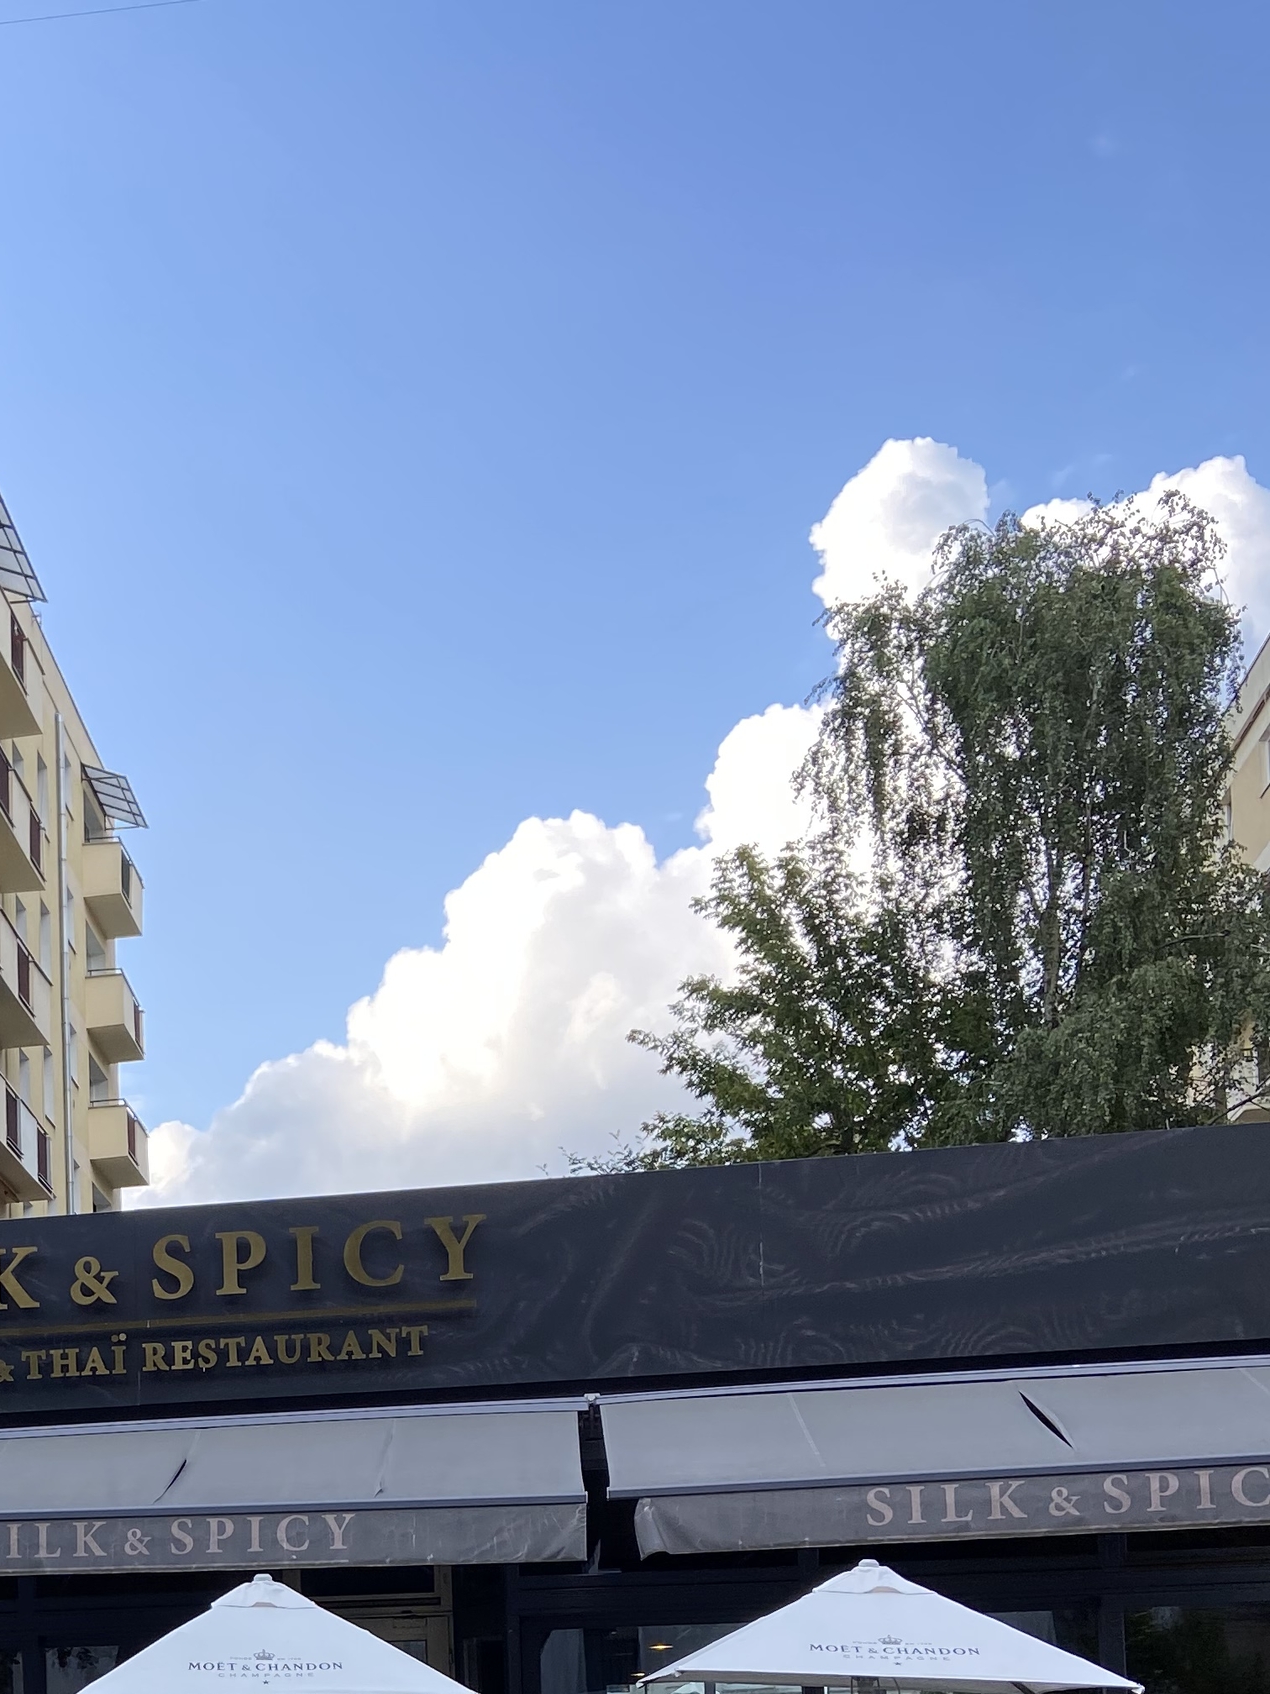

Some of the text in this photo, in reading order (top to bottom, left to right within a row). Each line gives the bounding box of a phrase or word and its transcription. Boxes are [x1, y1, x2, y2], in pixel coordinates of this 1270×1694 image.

[69, 1255, 119, 1305] &
[150, 1213, 487, 1300] SPICY
[21, 1334, 128, 1379] THAÏ
[141, 1324, 428, 1372] RESTAURANT
[866, 1467, 1270, 1527] SILK & SPIC
[124, 1528, 152, 1555] &
[170, 1513, 355, 1555] SPICY
[255, 1662, 343, 1671] CHANDON
[882, 1647, 980, 1655] CHANDON
